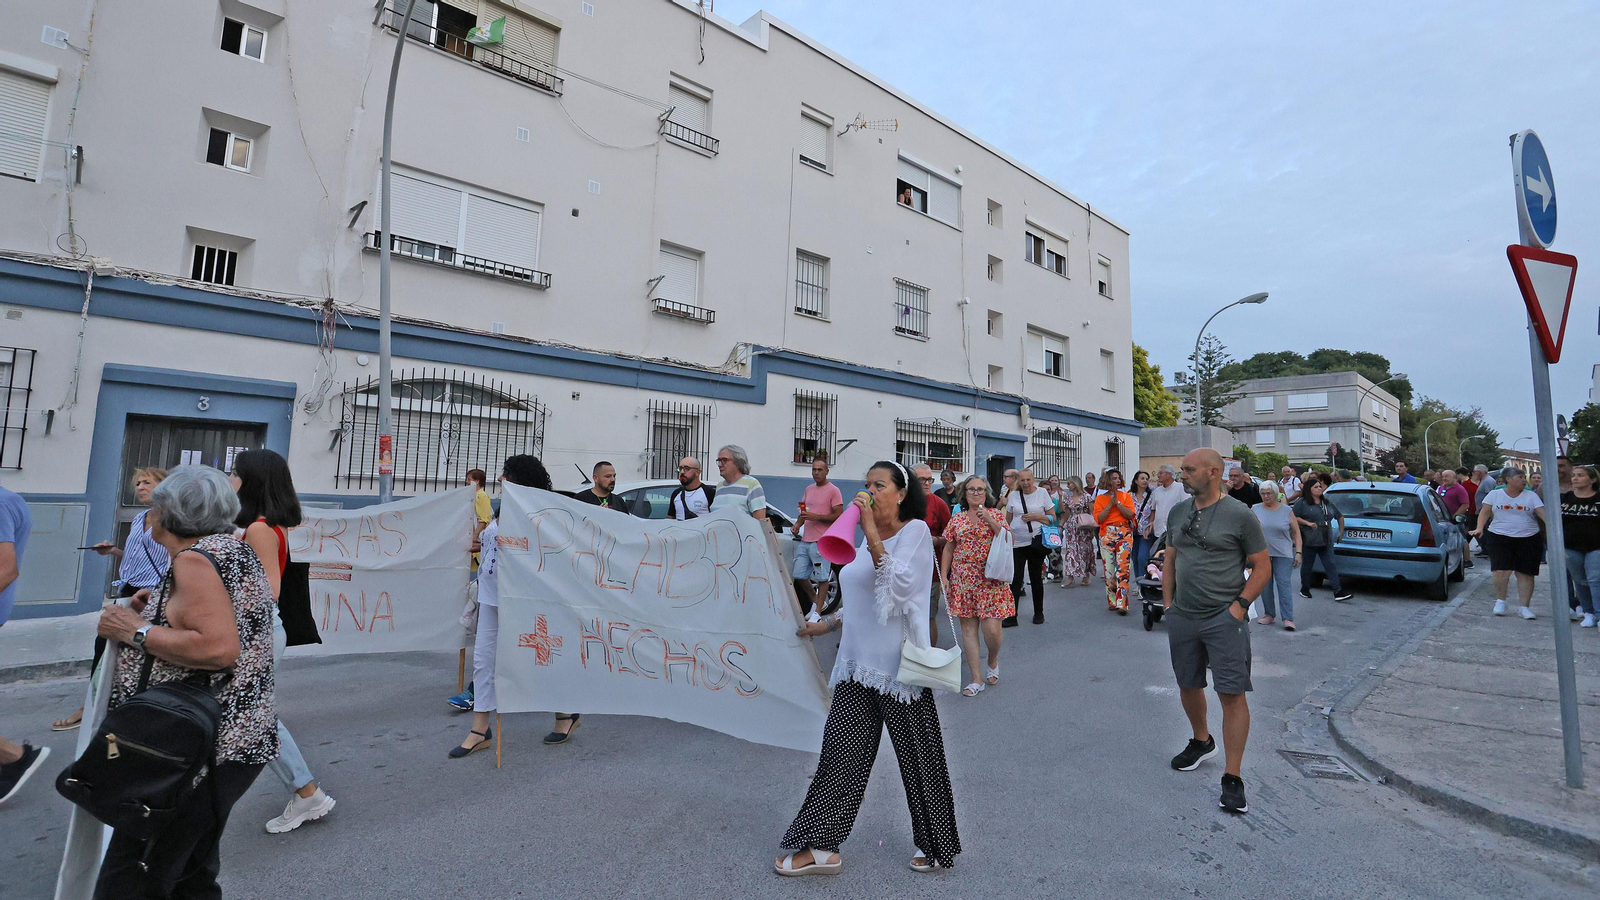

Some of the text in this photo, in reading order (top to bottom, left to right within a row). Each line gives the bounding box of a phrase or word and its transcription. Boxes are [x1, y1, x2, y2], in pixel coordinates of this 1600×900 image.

[197, 395, 211, 412] 3
[1347, 530, 1369, 539] 6944
[580, 617, 763, 698] HECHOS
